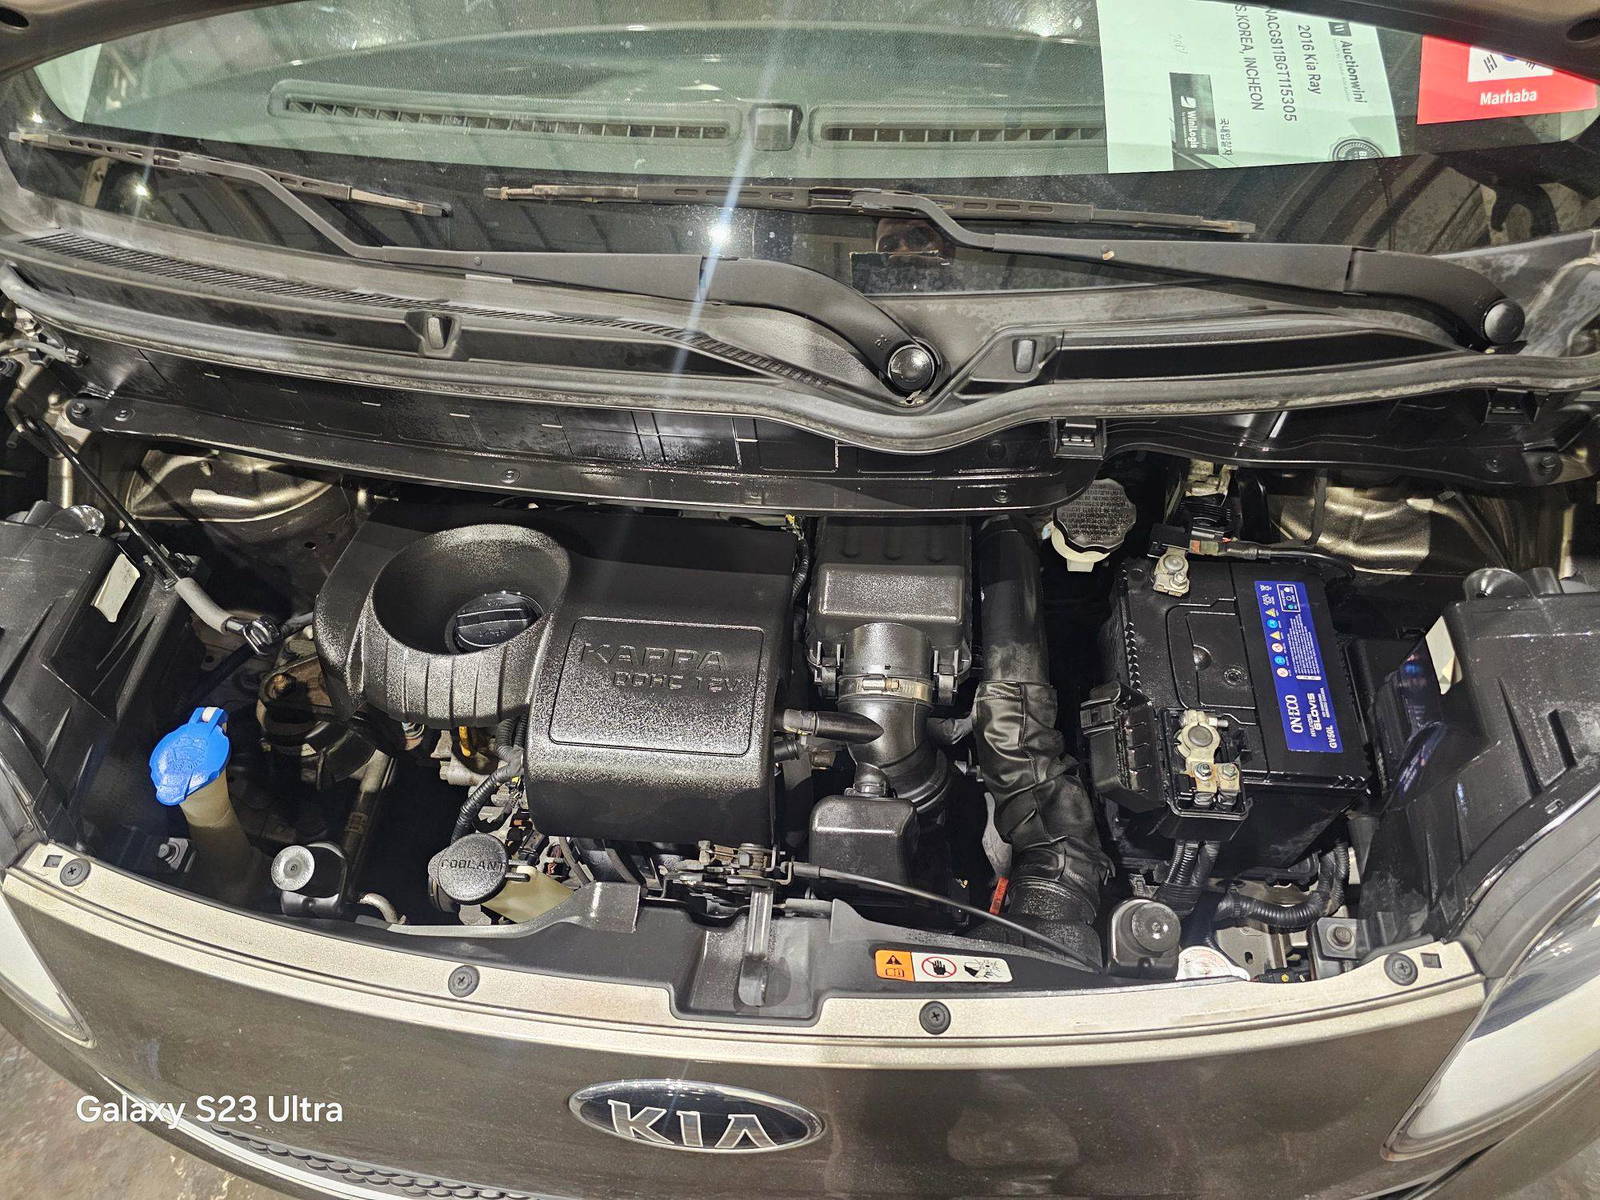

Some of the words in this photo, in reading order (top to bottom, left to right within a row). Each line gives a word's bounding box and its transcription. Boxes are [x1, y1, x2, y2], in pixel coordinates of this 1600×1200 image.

[1298, 24, 1314, 52] 2016
[1304, 53, 1317, 71] Kia
[1340, 40, 1368, 104] Auctionwini
[1244, 57, 1264, 111] INCHEON
[1307, 74, 1321, 95] Ray
[1480, 89, 1537, 106] Marhaba
[580, 642, 728, 672] KAPPA
[1306, 692, 1322, 732] GLOVIS
[441, 859, 505, 871] COOLANT
[607, 1099, 778, 1149] KIA
